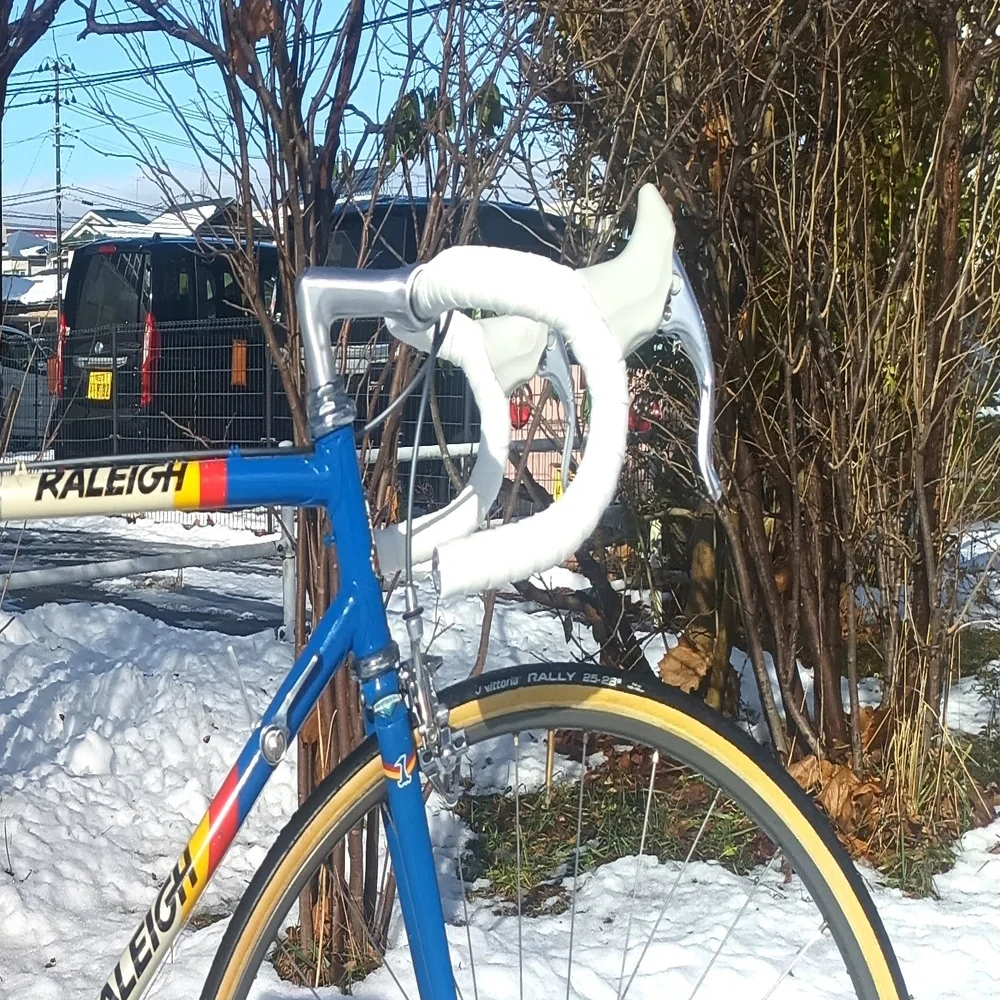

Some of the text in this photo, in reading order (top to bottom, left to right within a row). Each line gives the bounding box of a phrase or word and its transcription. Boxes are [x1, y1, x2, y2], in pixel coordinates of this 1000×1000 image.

[34, 461, 189, 501] RALEIGH
[484, 675, 520, 693] vittoria
[527, 671, 577, 683] RALLY
